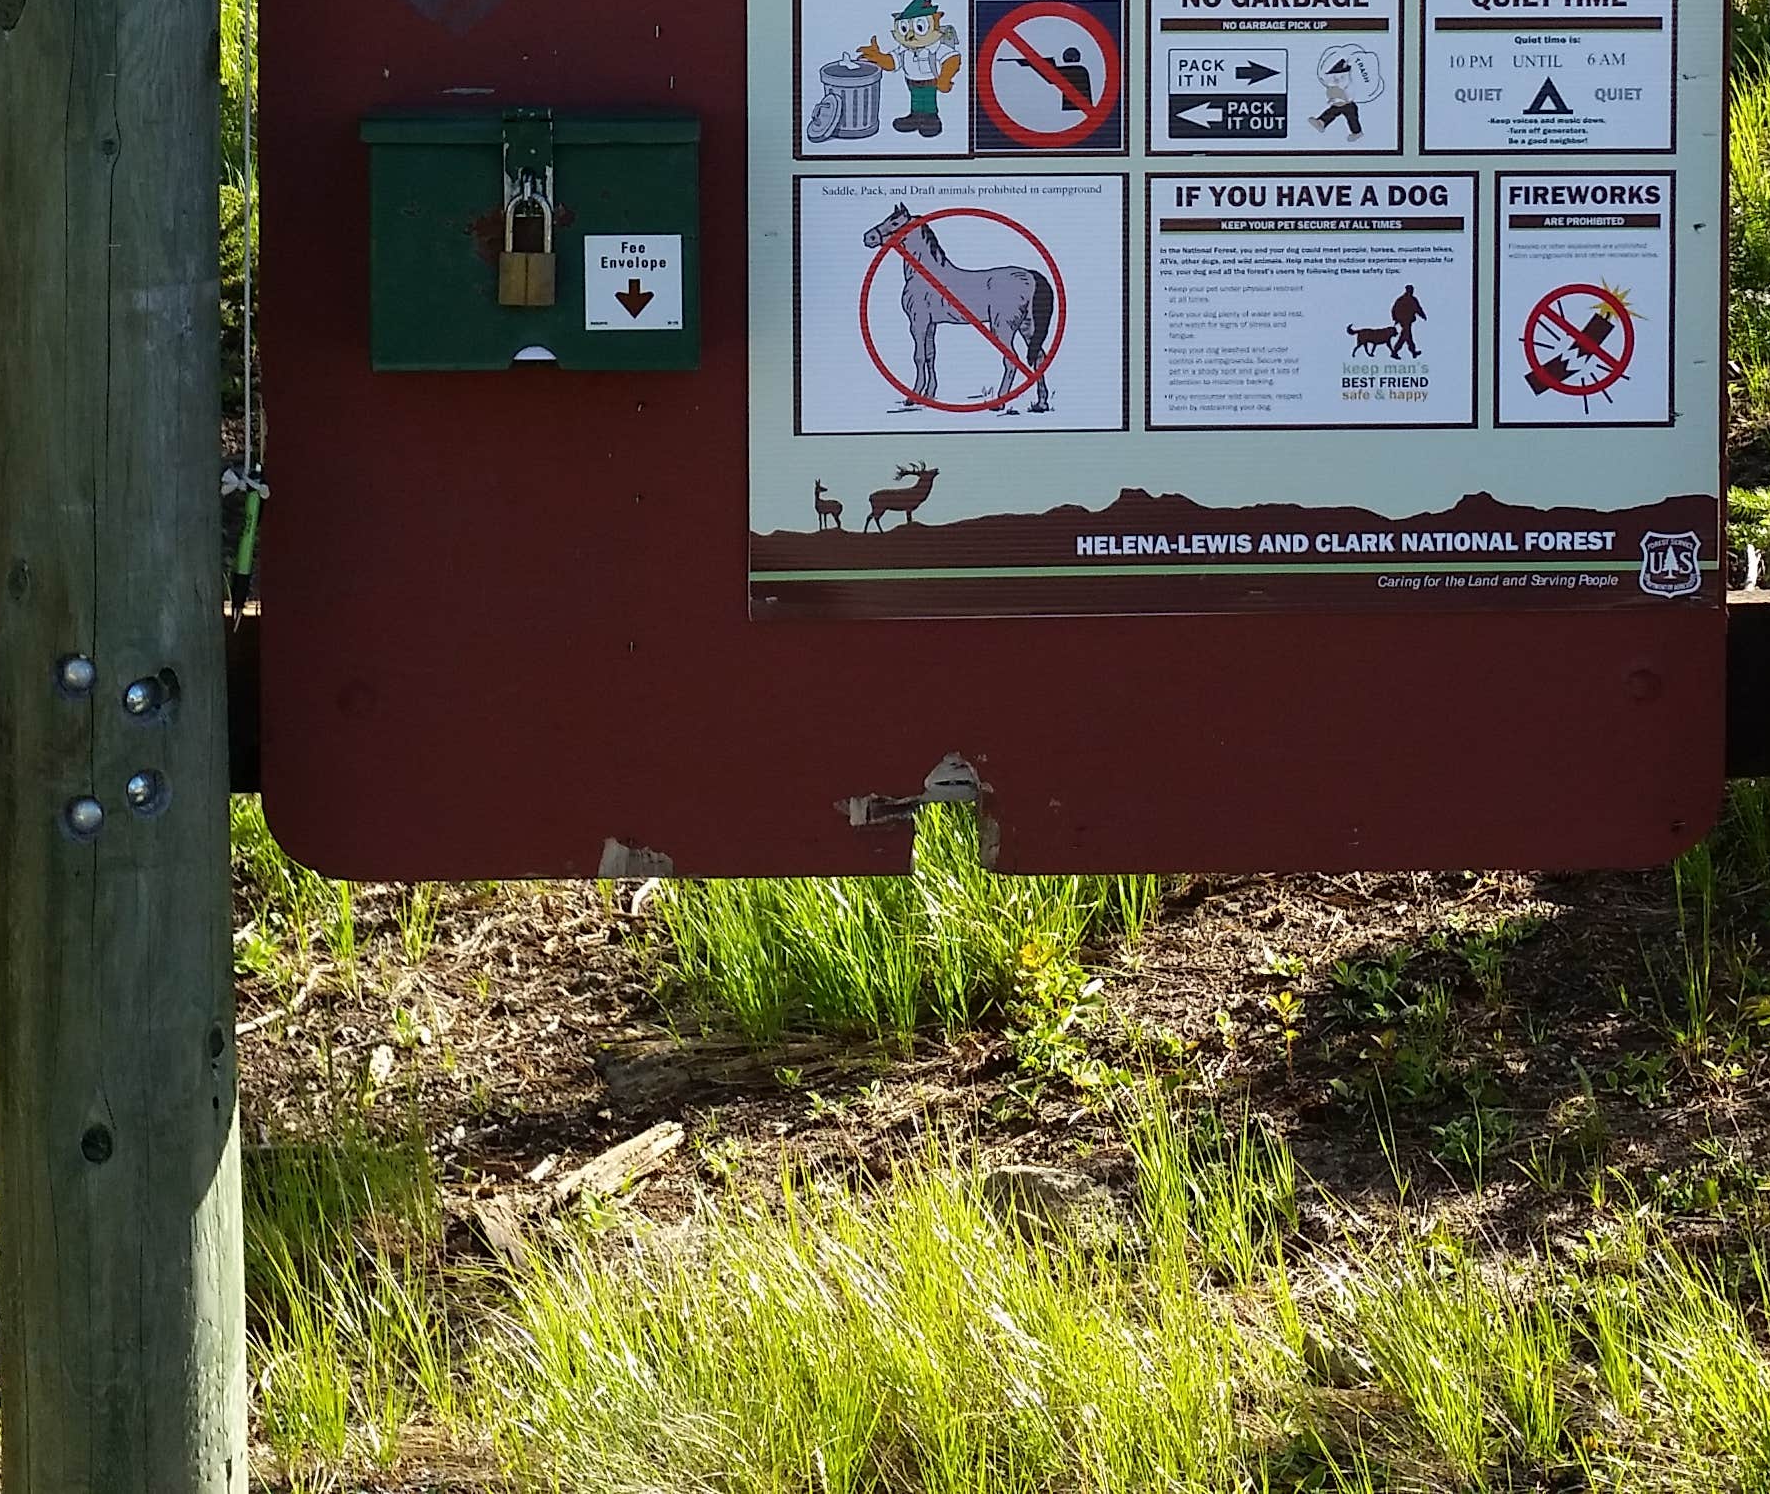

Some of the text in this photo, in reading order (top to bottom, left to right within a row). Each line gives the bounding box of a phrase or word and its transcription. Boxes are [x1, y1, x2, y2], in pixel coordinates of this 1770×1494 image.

[1179, 60, 1224, 71] PACK
[1179, 75, 1216, 86] IT IN
[1228, 102, 1274, 114] PACK
[1228, 117, 1285, 129] IT OUT
[1177, 185, 1447, 207] IF YOU HAVE A DOG
[1510, 186, 1660, 204] FIREWORKS
[622, 242, 645, 253] Fee
[601, 257, 666, 271] Envelope
[1342, 377, 1428, 388] BEST FRIEND
[1077, 532, 1615, 555] HELENA-LEWIS AND CLARK NATIONAL FOREST
